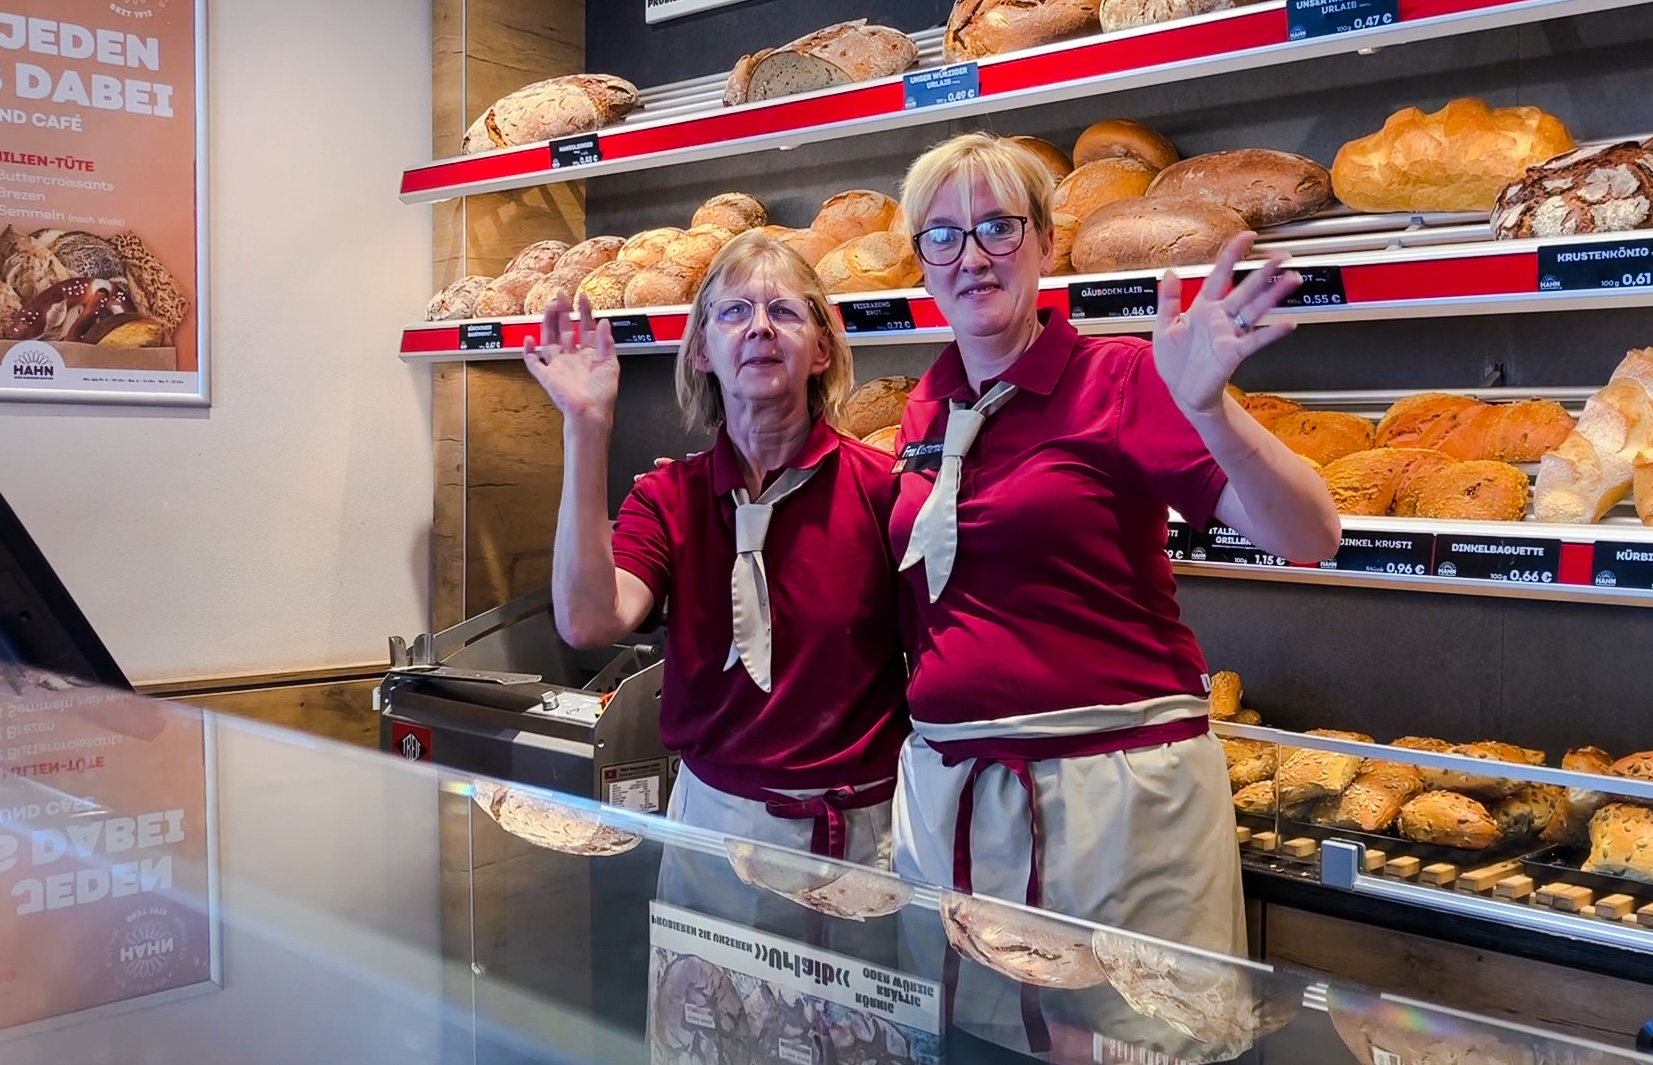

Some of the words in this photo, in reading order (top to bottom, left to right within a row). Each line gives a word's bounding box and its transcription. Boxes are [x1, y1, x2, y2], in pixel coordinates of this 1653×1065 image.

[109, 3, 131, 17] SEIT
[1321, 2, 1357, 15] URLAIB
[1353, 15, 1380, 29] 0,47
[1382, 13, 1392, 23] €
[0, 12, 159, 71] JEDEN
[15, 62, 174, 118] DABEI
[947, 91, 967, 102] 0,49
[967, 89, 975, 98] €
[32, 114, 83, 132] CAFÉ
[0, 169, 115, 192] Buttercroissants
[0, 186, 46, 202] Brezen
[0, 204, 65, 222] Semmeln
[1557, 246, 1650, 262] KRUSTENKÖNIG
[1622, 272, 1652, 287] 0,61
[1123, 286, 1143, 294] LAIB
[1331, 294, 1341, 303] €
[1122, 306, 1145, 317] 0,46
[1146, 305, 1155, 315] €
[886, 321, 904, 330] 0,72
[904, 321, 911, 329] €
[13, 365, 54, 377] HAHN
[1375, 540, 1413, 550] KRUSTI
[1451, 543, 1545, 557] DINKELBAGUETTE
[1255, 554, 1274, 565] 1,15
[1276, 556, 1286, 566] €
[1386, 562, 1413, 575] 0,96
[1414, 564, 1425, 575] €
[1509, 569, 1540, 583] 0,66
[1541, 572, 1553, 583] €
